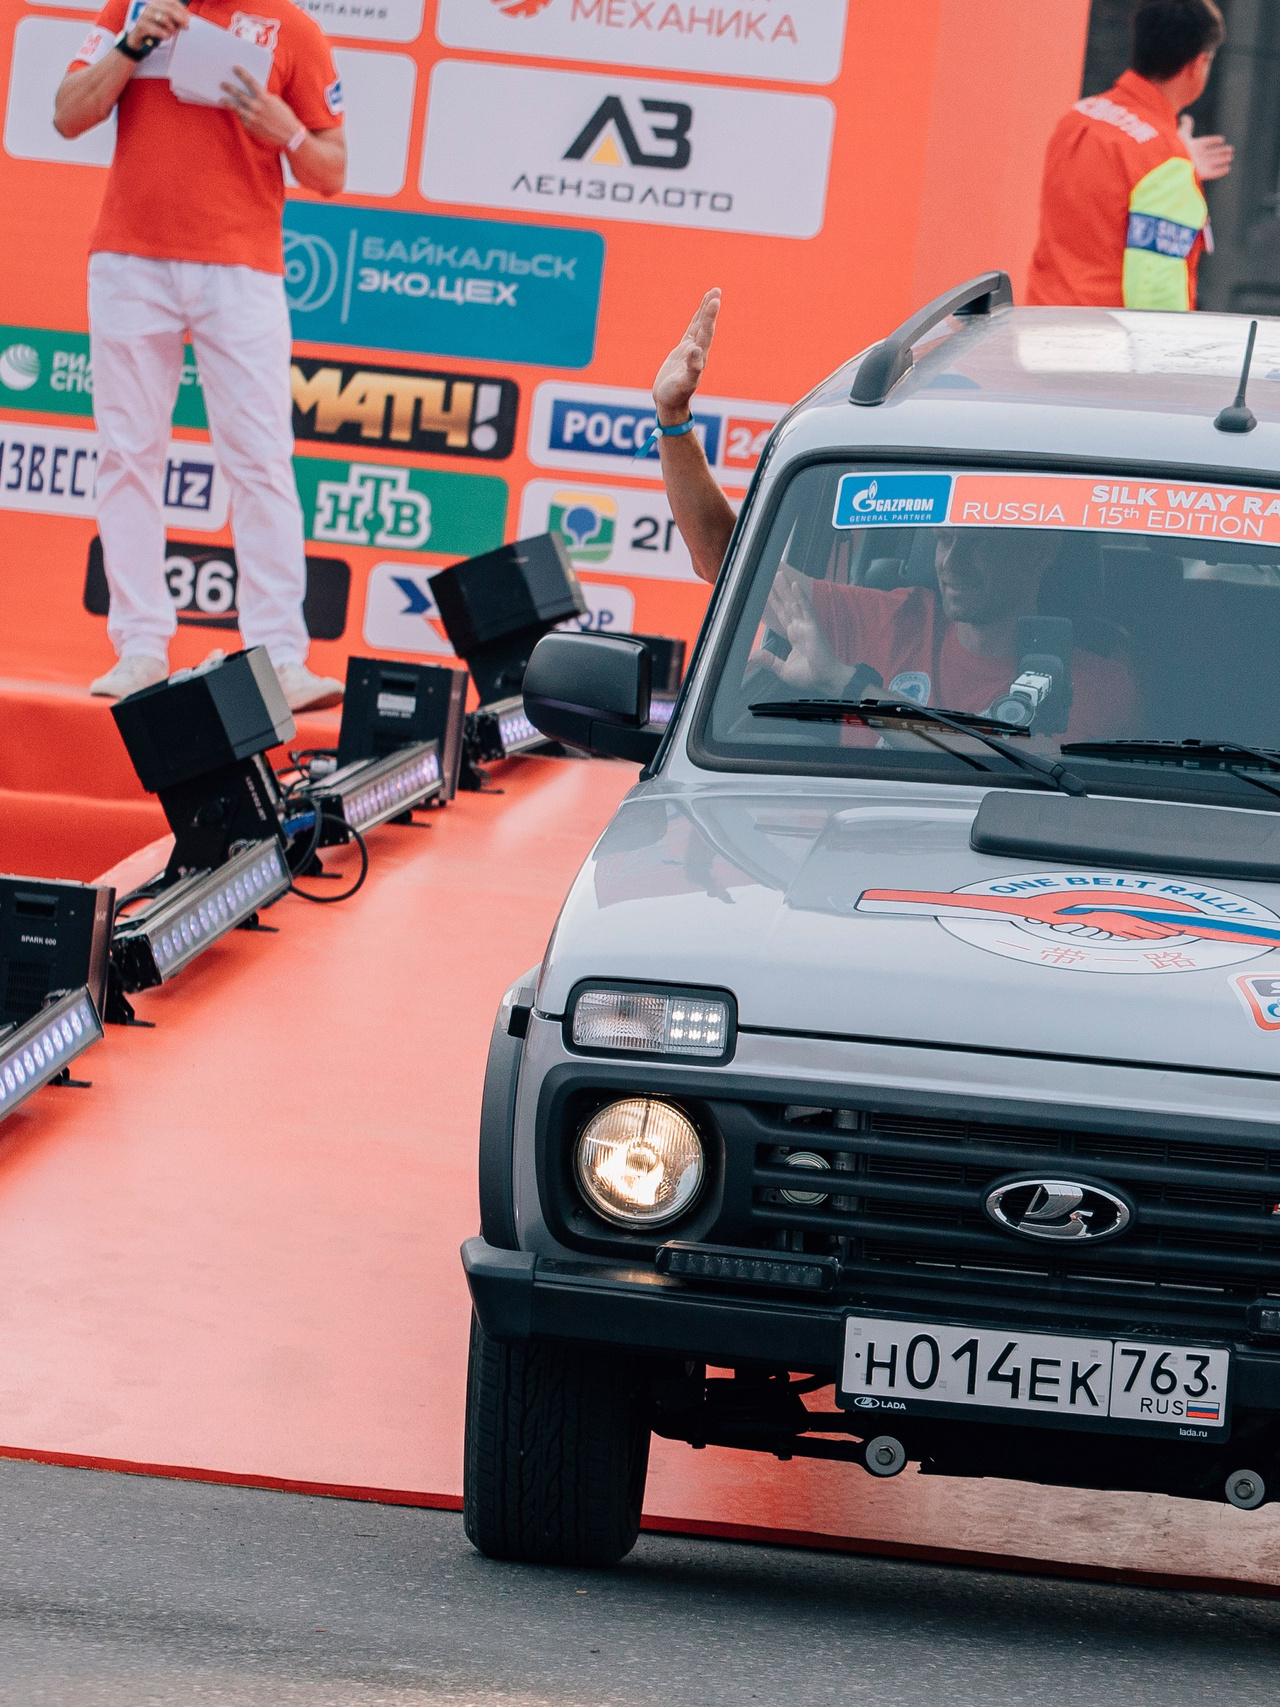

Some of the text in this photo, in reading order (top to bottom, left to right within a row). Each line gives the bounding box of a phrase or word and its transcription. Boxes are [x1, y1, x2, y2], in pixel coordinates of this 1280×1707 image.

[570, 0, 798, 44] МЕХАНИКА
[512, 173, 734, 212] ЛЕНЗОЛОТО
[362, 236, 578, 280] БАЙКАЛЬСК
[356, 267, 519, 307] ЭКО.ЦЕХ
[50, 370, 93, 393] СПО
[290, 364, 501, 451] МАТЧ!
[562, 409, 706, 452] РОСС
[0, 440, 97, 500] ЗВЕС
[315, 464, 430, 548] НТВ
[849, 513, 932, 523] GENERAL PARTNER
[875, 498, 934, 512] GAZPROM
[1091, 485, 1158, 506] SILK
[1166, 489, 1238, 513] WAY
[962, 502, 1066, 523] RUSSIA
[1097, 506, 1140, 525] 15th
[1147, 510, 1265, 538] EDITION
[989, 876, 1256, 916] ONE BELT RALLY
[995, 940, 1197, 970] 一带一路
[1120, 1348, 1210, 1398] 763
[880, 1400, 907, 1411] LADA
[1140, 1397, 1185, 1416] RUS
[1178, 1427, 1208, 1438] lada.ru
